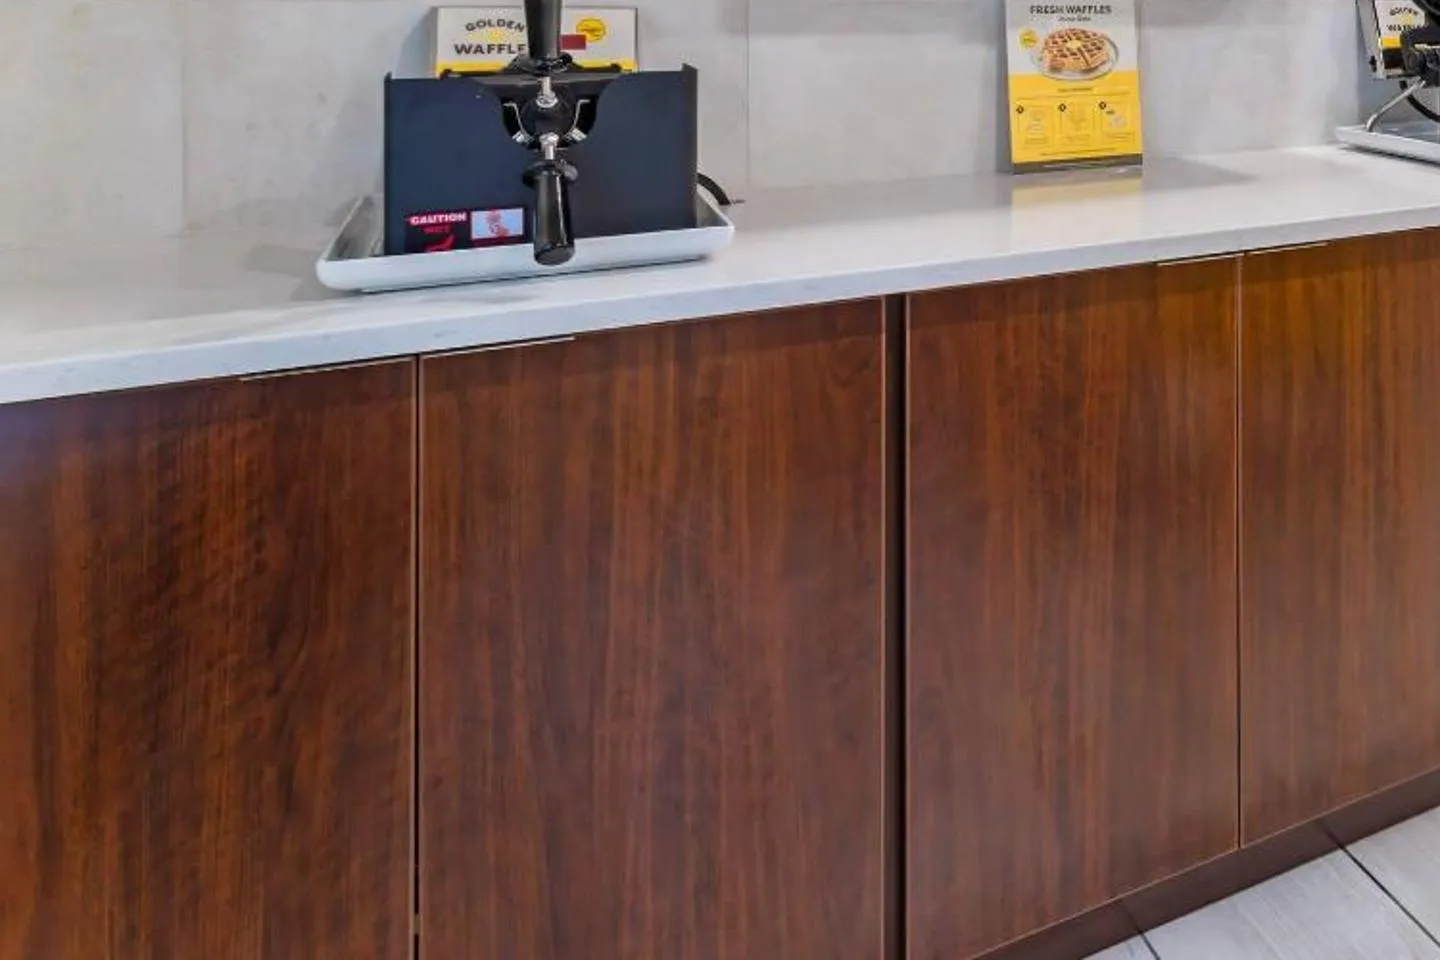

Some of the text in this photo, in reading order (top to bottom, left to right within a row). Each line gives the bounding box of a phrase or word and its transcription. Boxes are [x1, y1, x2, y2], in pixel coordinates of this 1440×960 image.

[1029, 5, 1112, 14] FRESH WAFFLES
[465, 18, 525, 32] GOLDEN
[454, 43, 528, 55] WAFFLE
[409, 212, 467, 226] CAUTION
